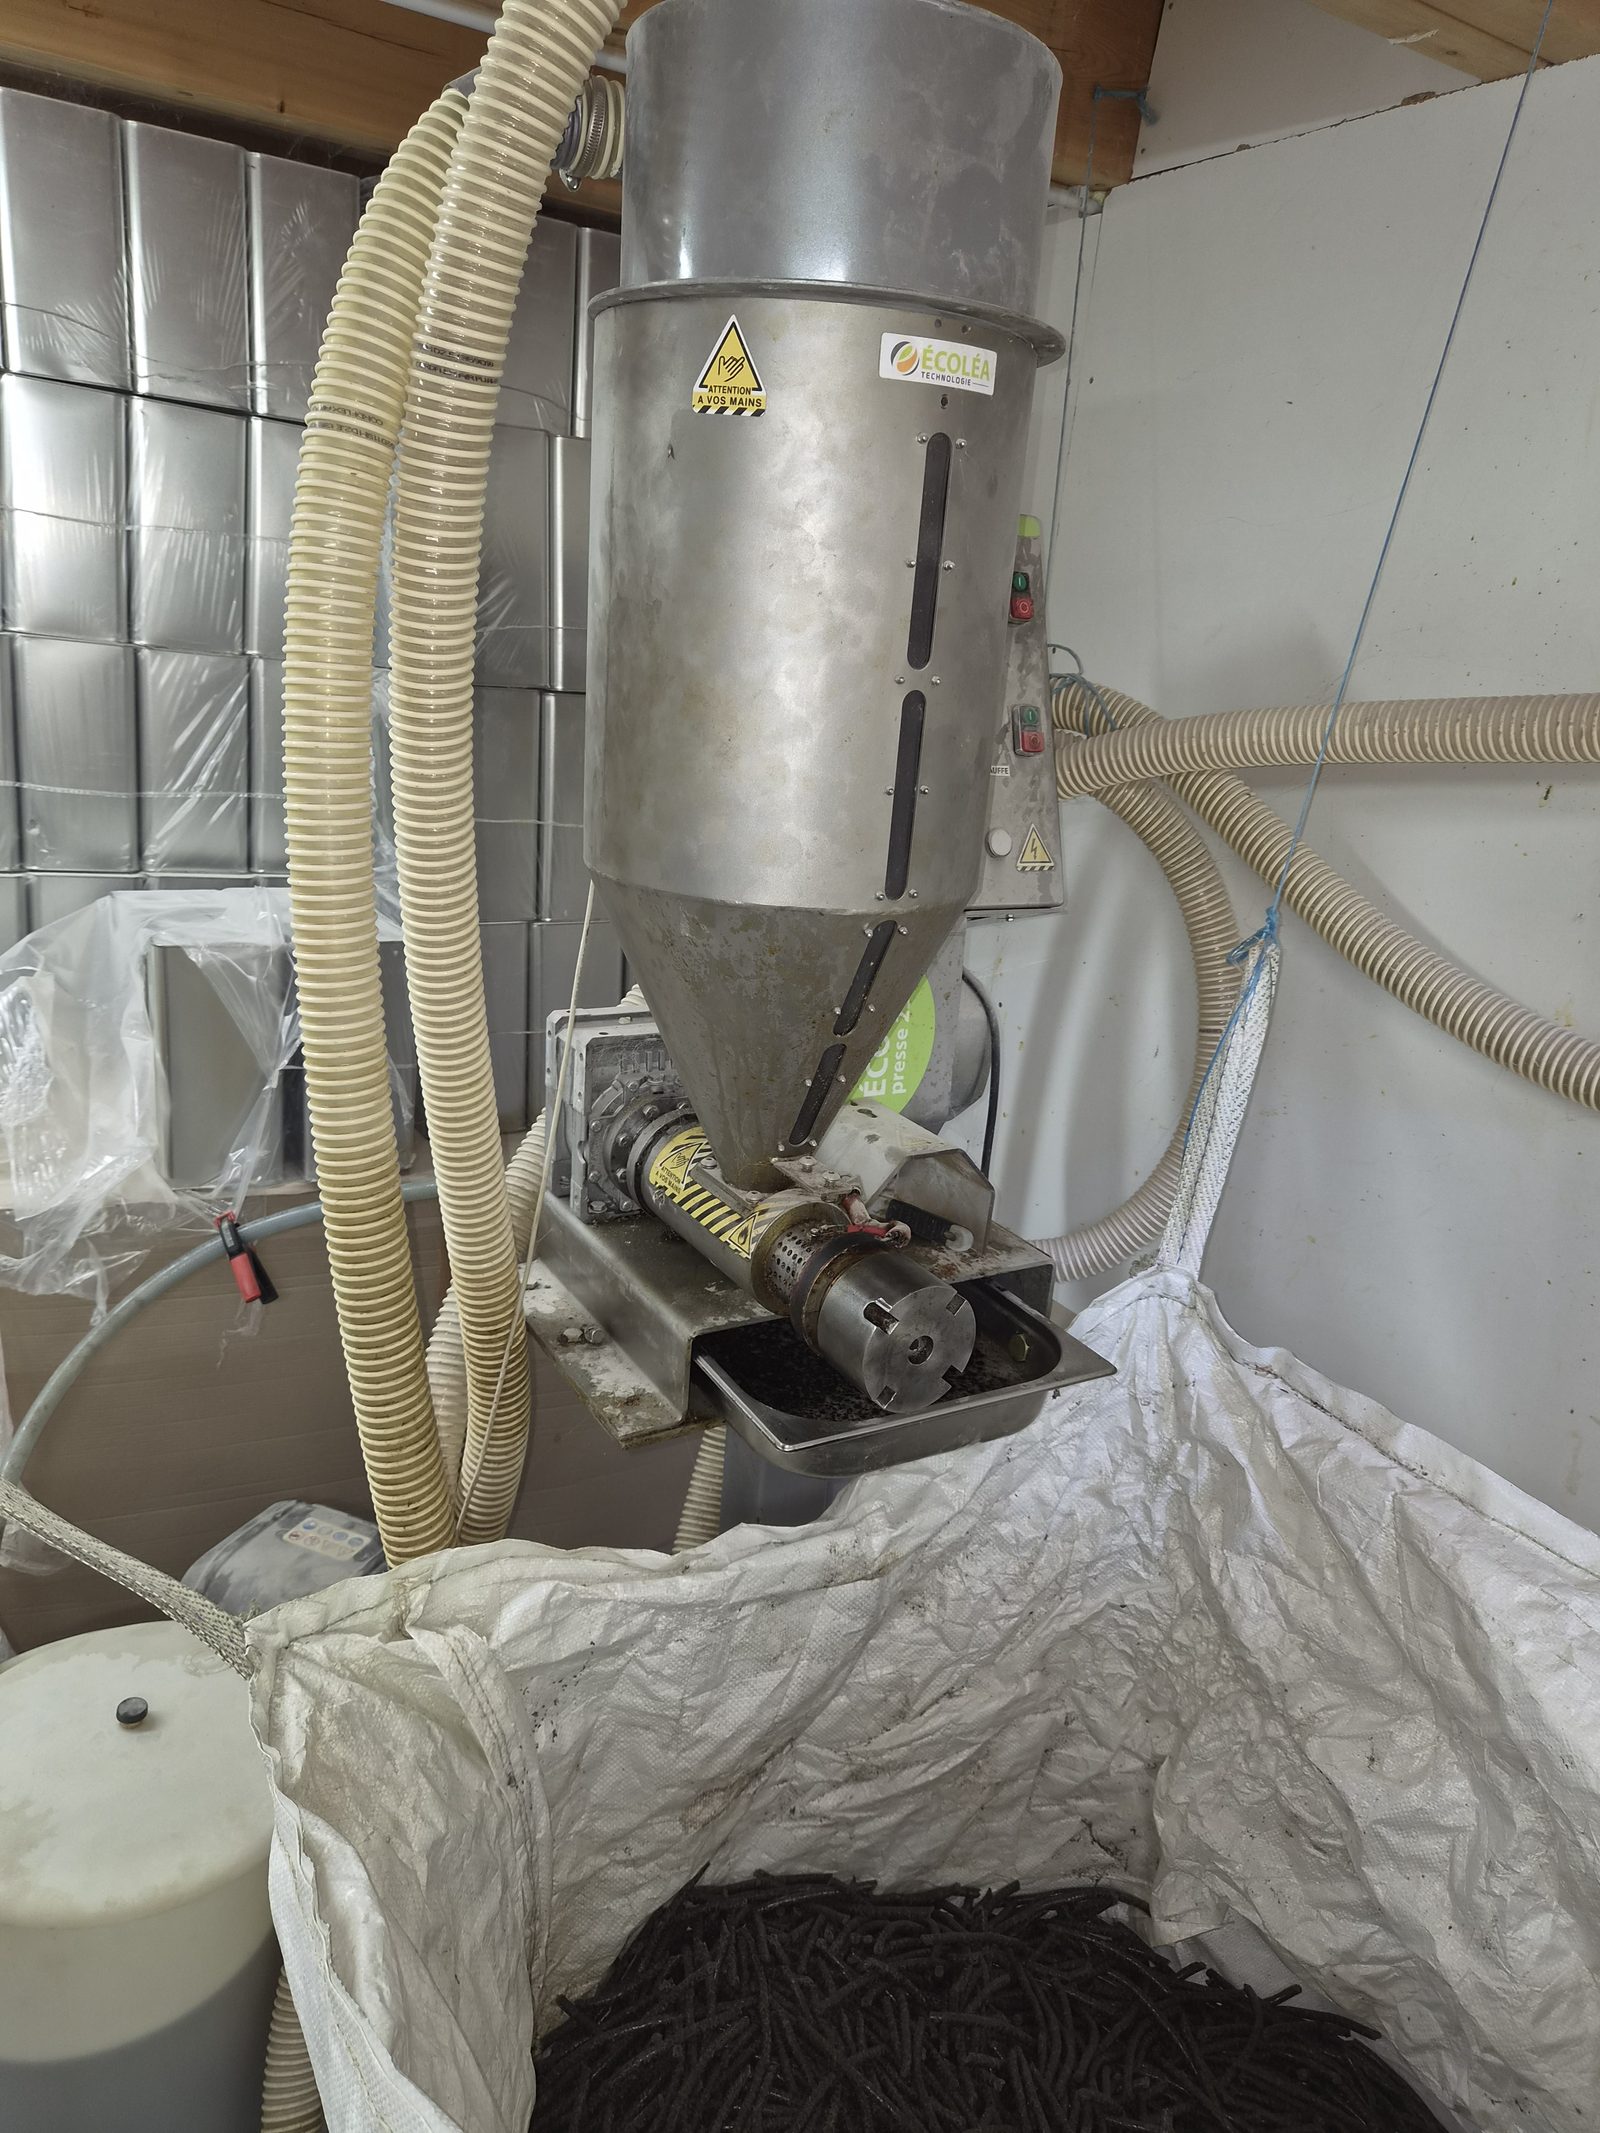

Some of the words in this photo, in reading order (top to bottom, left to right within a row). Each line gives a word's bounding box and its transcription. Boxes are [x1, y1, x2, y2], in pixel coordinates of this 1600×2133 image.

[921, 344, 990, 381] ÉCOLÉA
[921, 371, 972, 386] TECHNOLOGIE
[708, 385, 752, 395] ATTENTION
[697, 395, 704, 404] A
[707, 396, 726, 405] VOS
[729, 396, 762, 407] MAINS
[892, 1029, 908, 1094] presse
